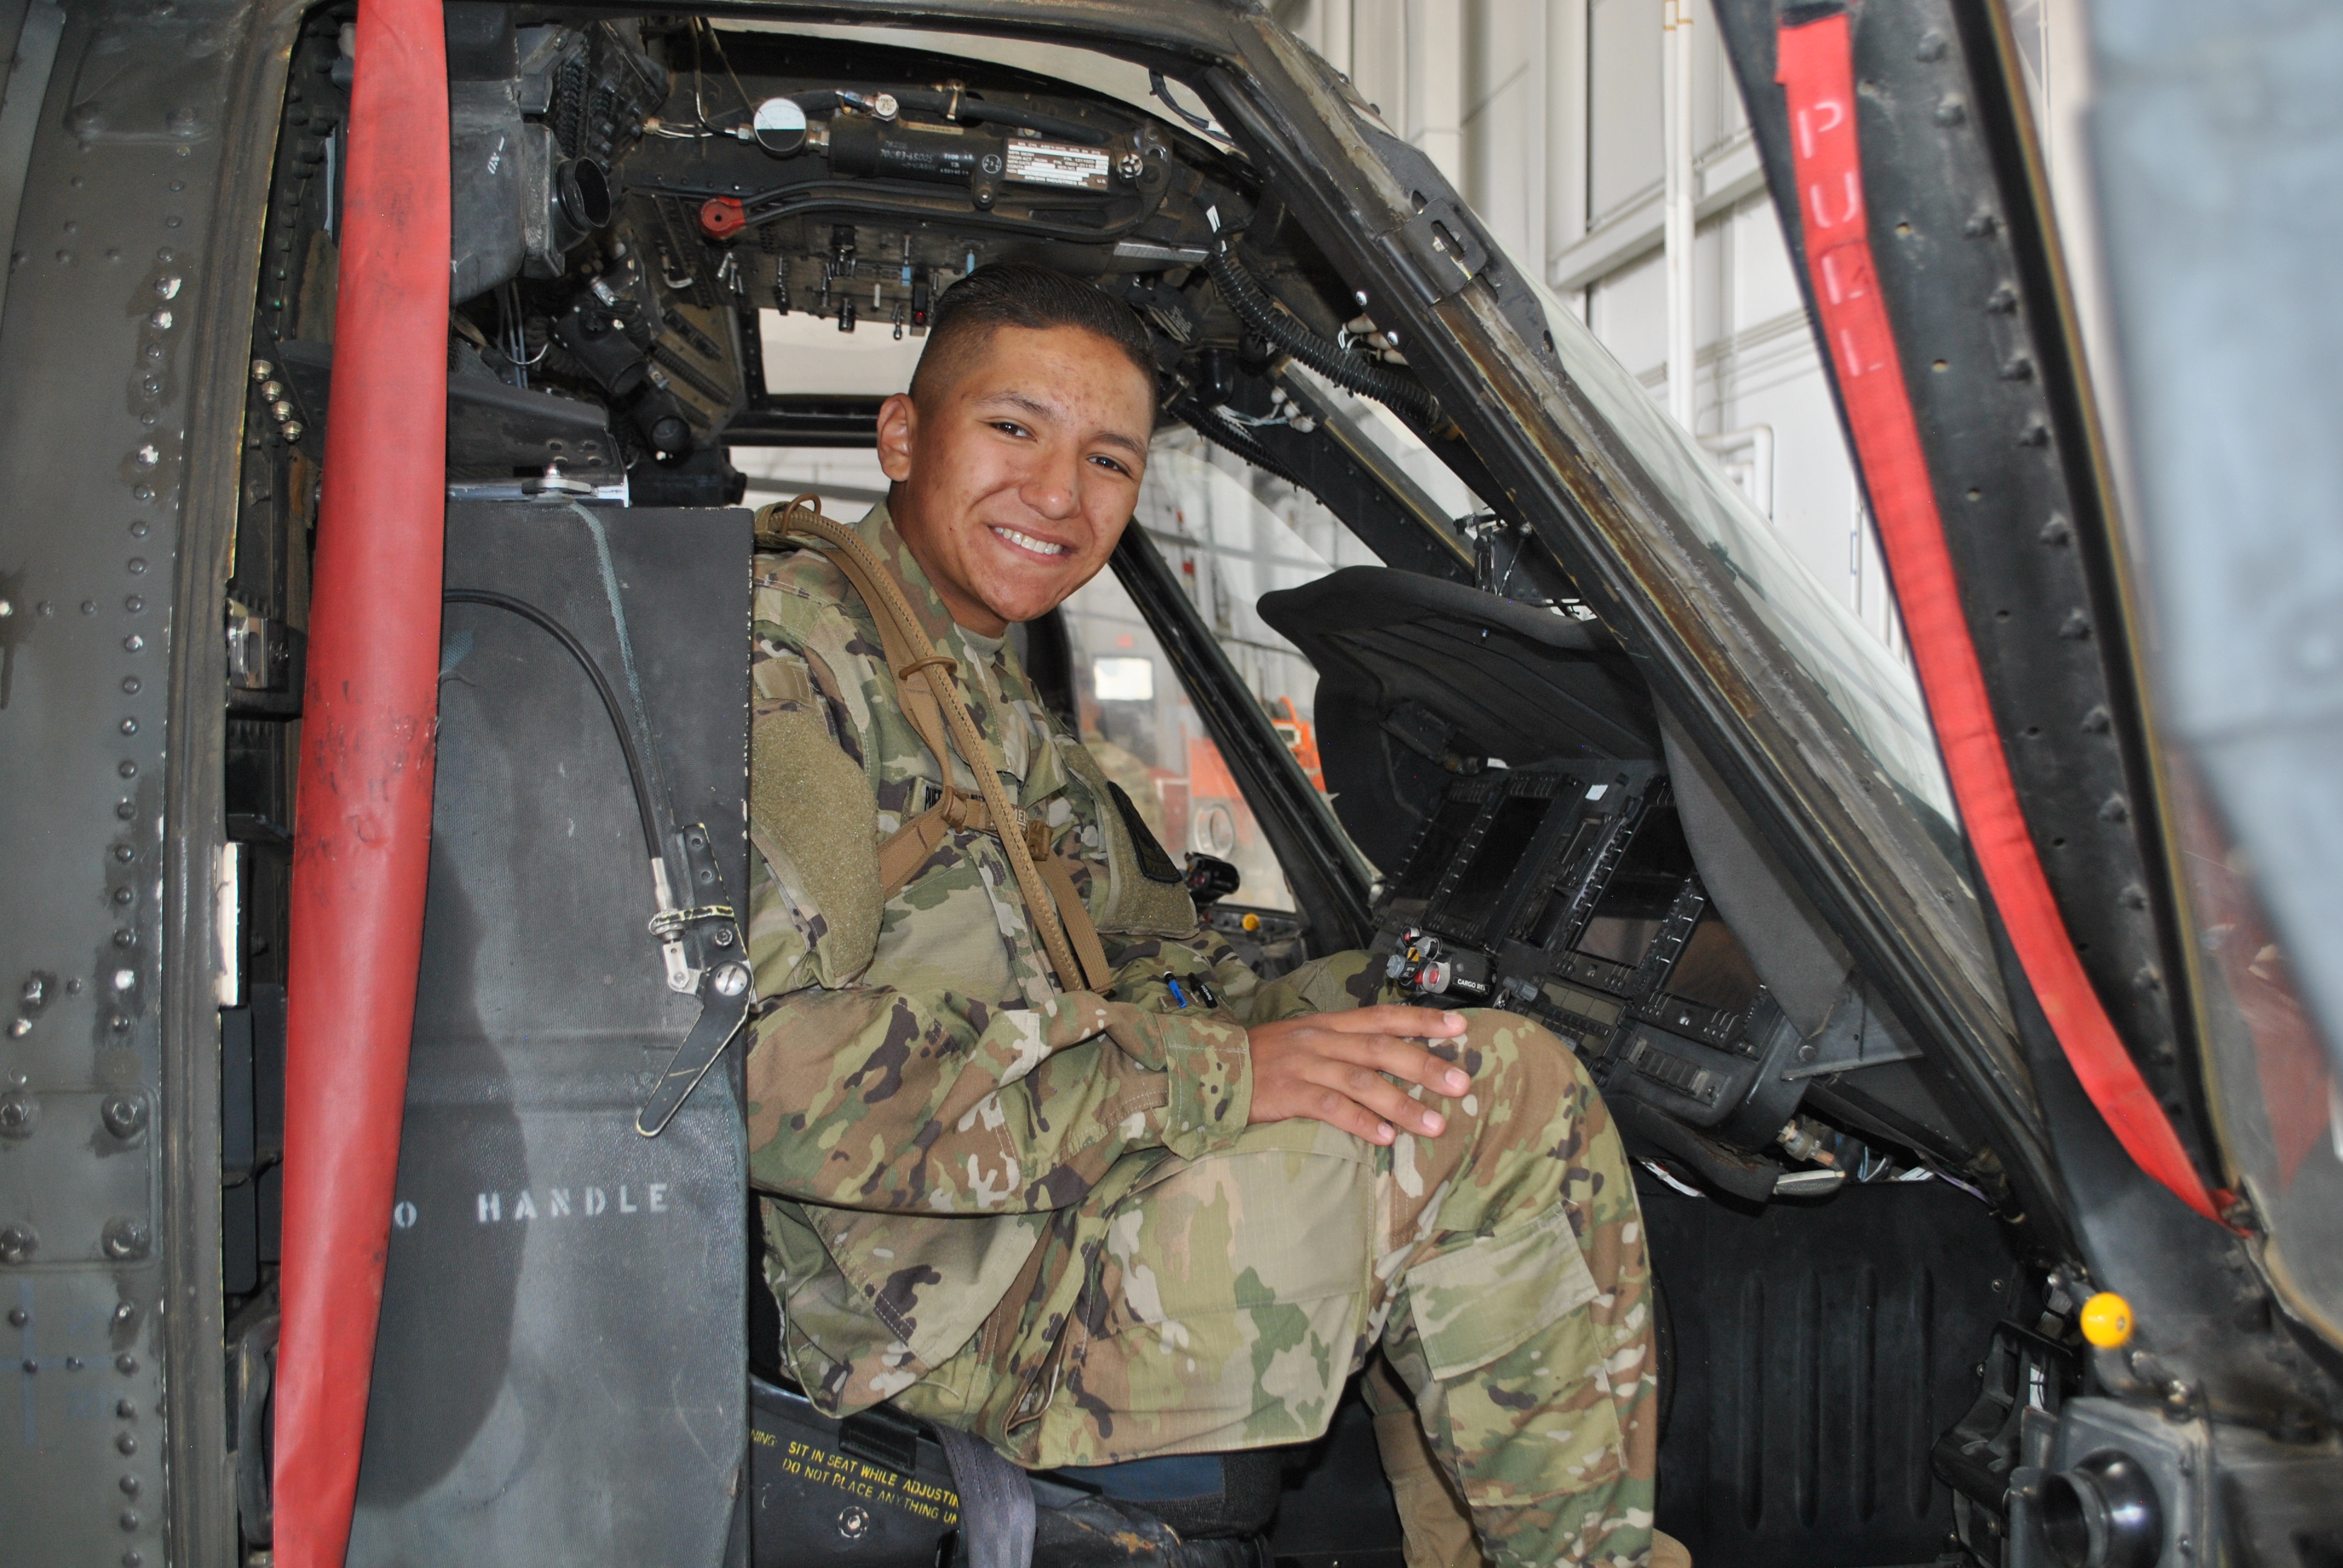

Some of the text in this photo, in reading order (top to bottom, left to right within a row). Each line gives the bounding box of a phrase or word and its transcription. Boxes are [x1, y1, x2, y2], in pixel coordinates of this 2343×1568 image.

[1797, 101, 1883, 377] PULL
[1457, 978, 1476, 988] CARGO
[478, 1183, 667, 1223] HANDLE
[788, 1441, 810, 1457] SIT
[811, 1449, 825, 1463] IN
[827, 1455, 858, 1473] SEAT
[860, 1465, 898, 1486] WHILE
[782, 1459, 801, 1474] DO
[804, 1465, 830, 1483] NOT
[832, 1472, 874, 1498] PLACE
[877, 1489, 939, 1519] ANYTHING
